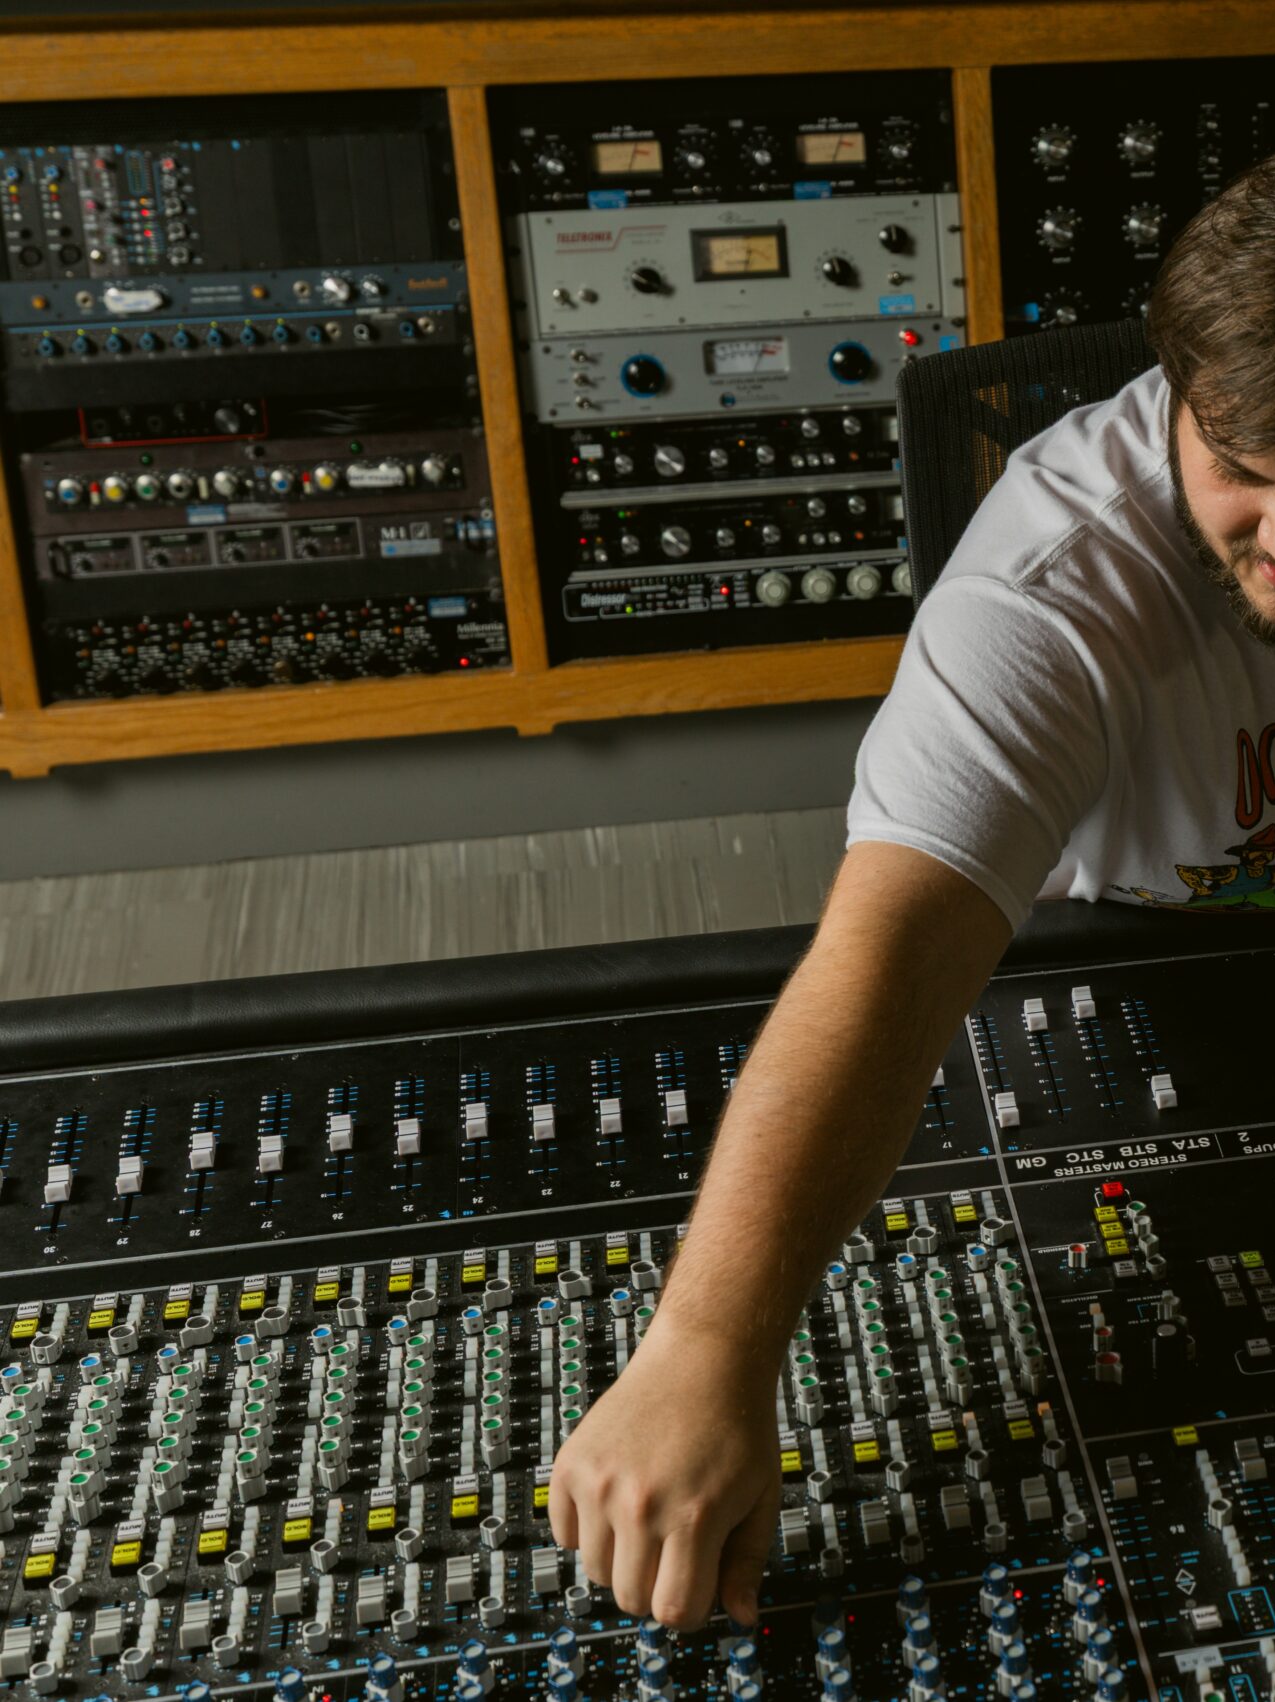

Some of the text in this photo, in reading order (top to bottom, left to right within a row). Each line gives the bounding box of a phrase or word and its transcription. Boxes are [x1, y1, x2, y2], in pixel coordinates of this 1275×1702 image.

[1238, 1131, 1249, 1142] 2
[1172, 1137, 1211, 1150] STA
[1119, 1143, 1158, 1156] STB
[1066, 1149, 1105, 1162] STC
[1016, 1156, 1047, 1170] GM
[1054, 1154, 1187, 1177] STEREO MASTERS
[678, 1172, 688, 1180] 21
[610, 1180, 621, 1188] 22
[473, 1196, 484, 1204] 24
[332, 1212, 343, 1220] 26
[189, 1229, 201, 1237] 28
[242, 1295, 261, 1303] SOLO
[166, 1304, 186, 1312] SOLO
[90, 1313, 110, 1321] SOLO
[853, 1424, 871, 1432] MUTE
[454, 1500, 475, 1508] SOLO
[370, 1513, 392, 1521] SOLO
[285, 1524, 307, 1532] SOLO
[1169, 1525, 1185, 1533] R6
[201, 1535, 223, 1543] SOLO
[115, 1547, 137, 1555] SOLO
[28, 1559, 50, 1567] SOLO
[492, 1658, 503, 1666] IN
